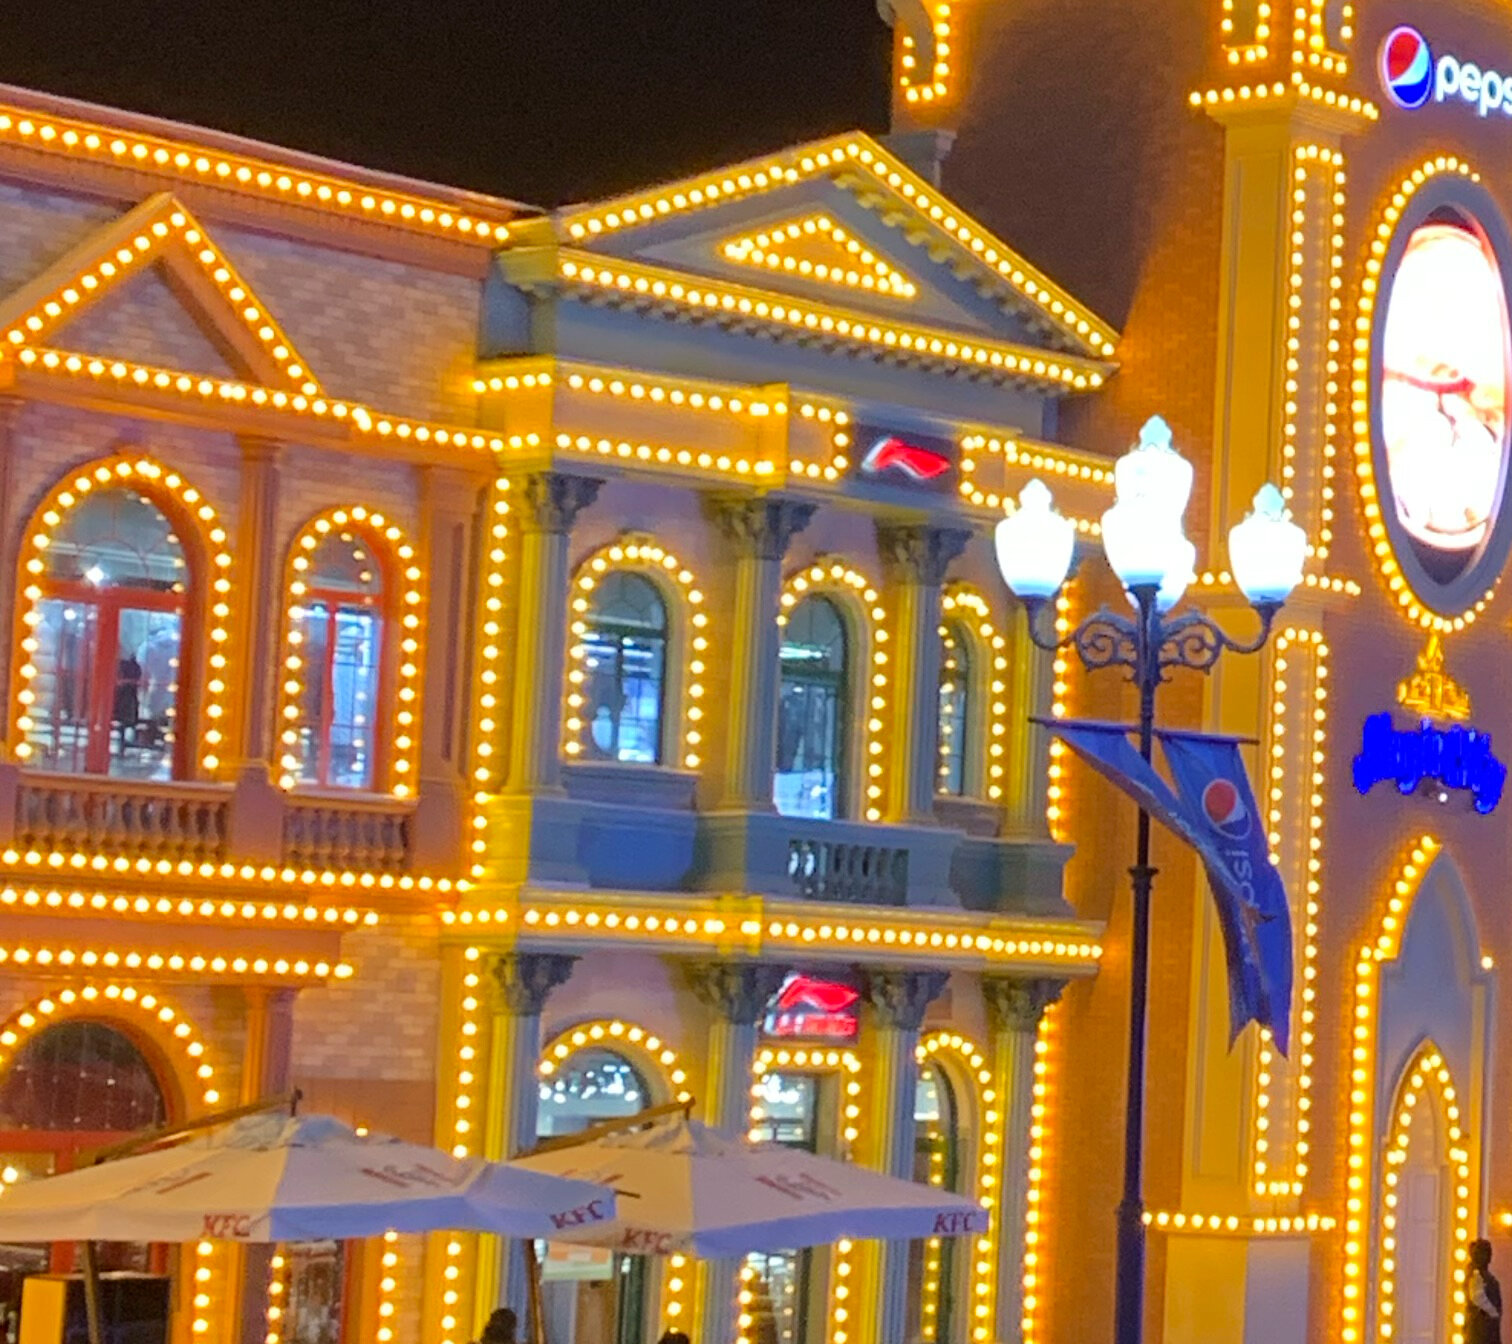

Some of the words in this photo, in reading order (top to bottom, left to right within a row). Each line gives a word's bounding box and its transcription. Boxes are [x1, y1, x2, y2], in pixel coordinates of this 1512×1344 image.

[203, 1213, 250, 1238] KFC
[549, 1200, 604, 1229] KFC
[933, 1211, 976, 1233] KFC
[623, 1227, 673, 1255] KFC
